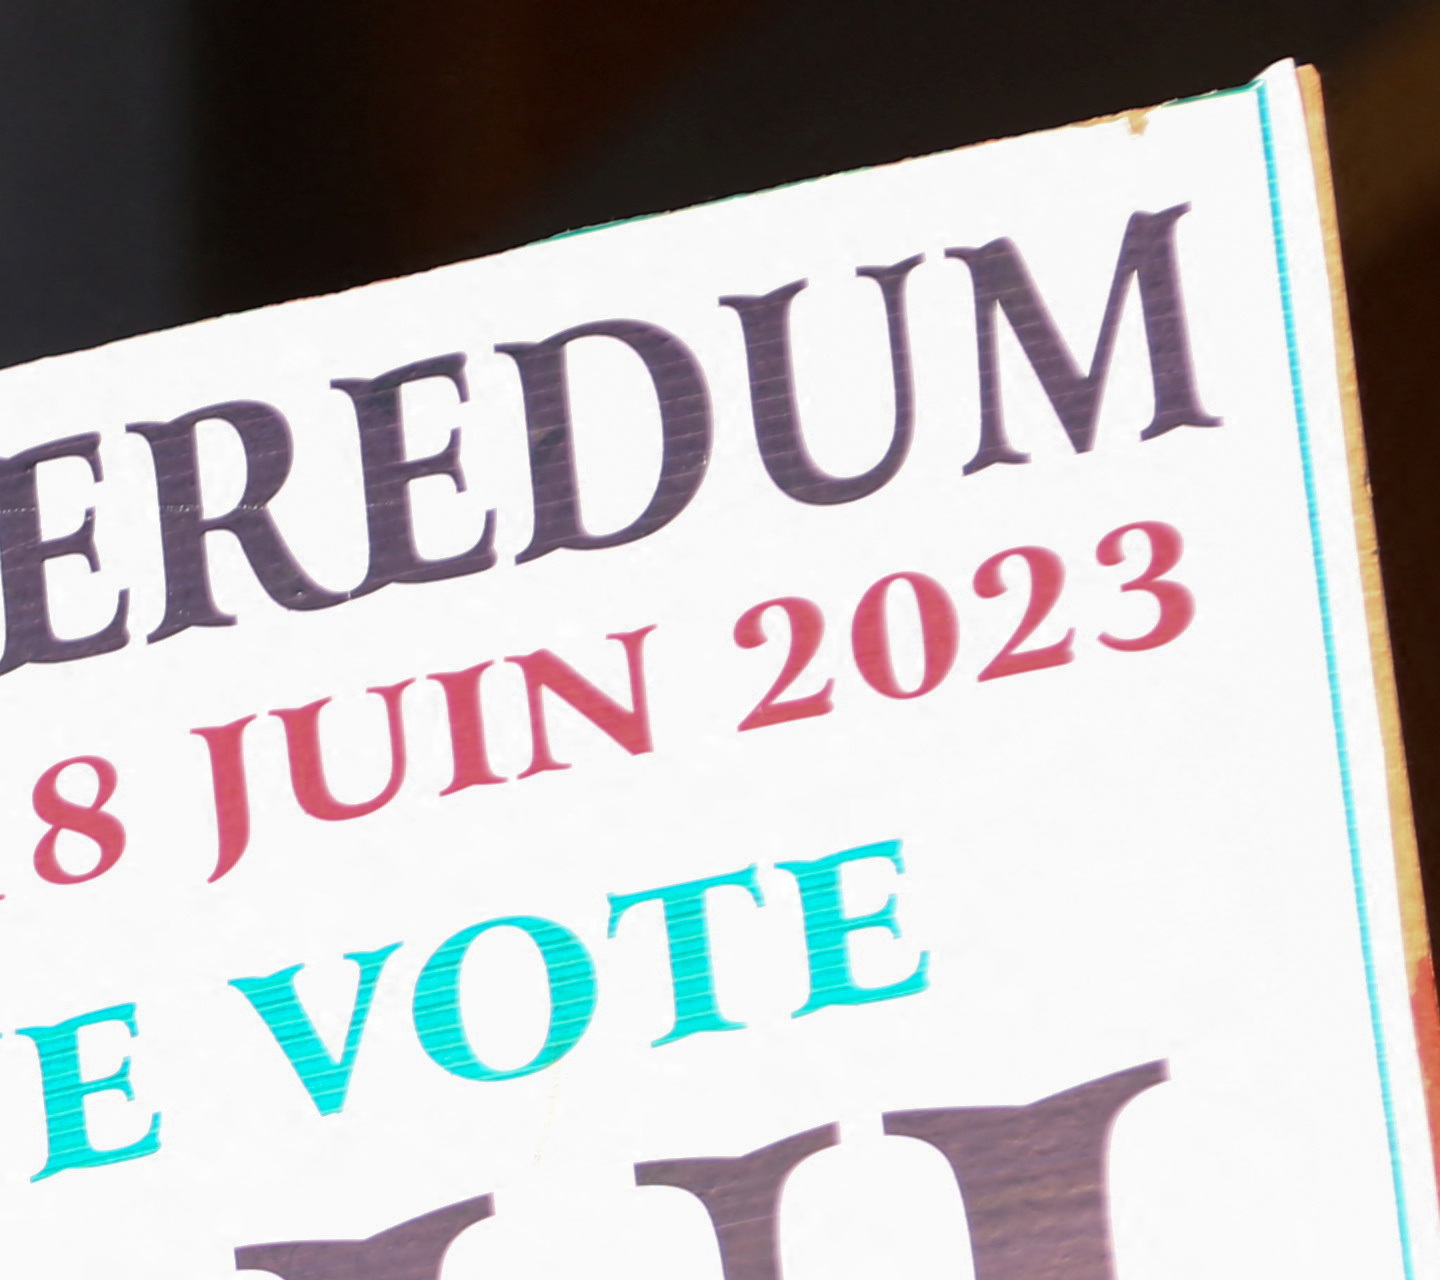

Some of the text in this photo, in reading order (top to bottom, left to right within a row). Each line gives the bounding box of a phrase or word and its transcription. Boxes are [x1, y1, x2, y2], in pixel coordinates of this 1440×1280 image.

[189, 623, 657, 885] JUIN
[732, 520, 1195, 733] 2023
[226, 837, 930, 1118] VOTE
